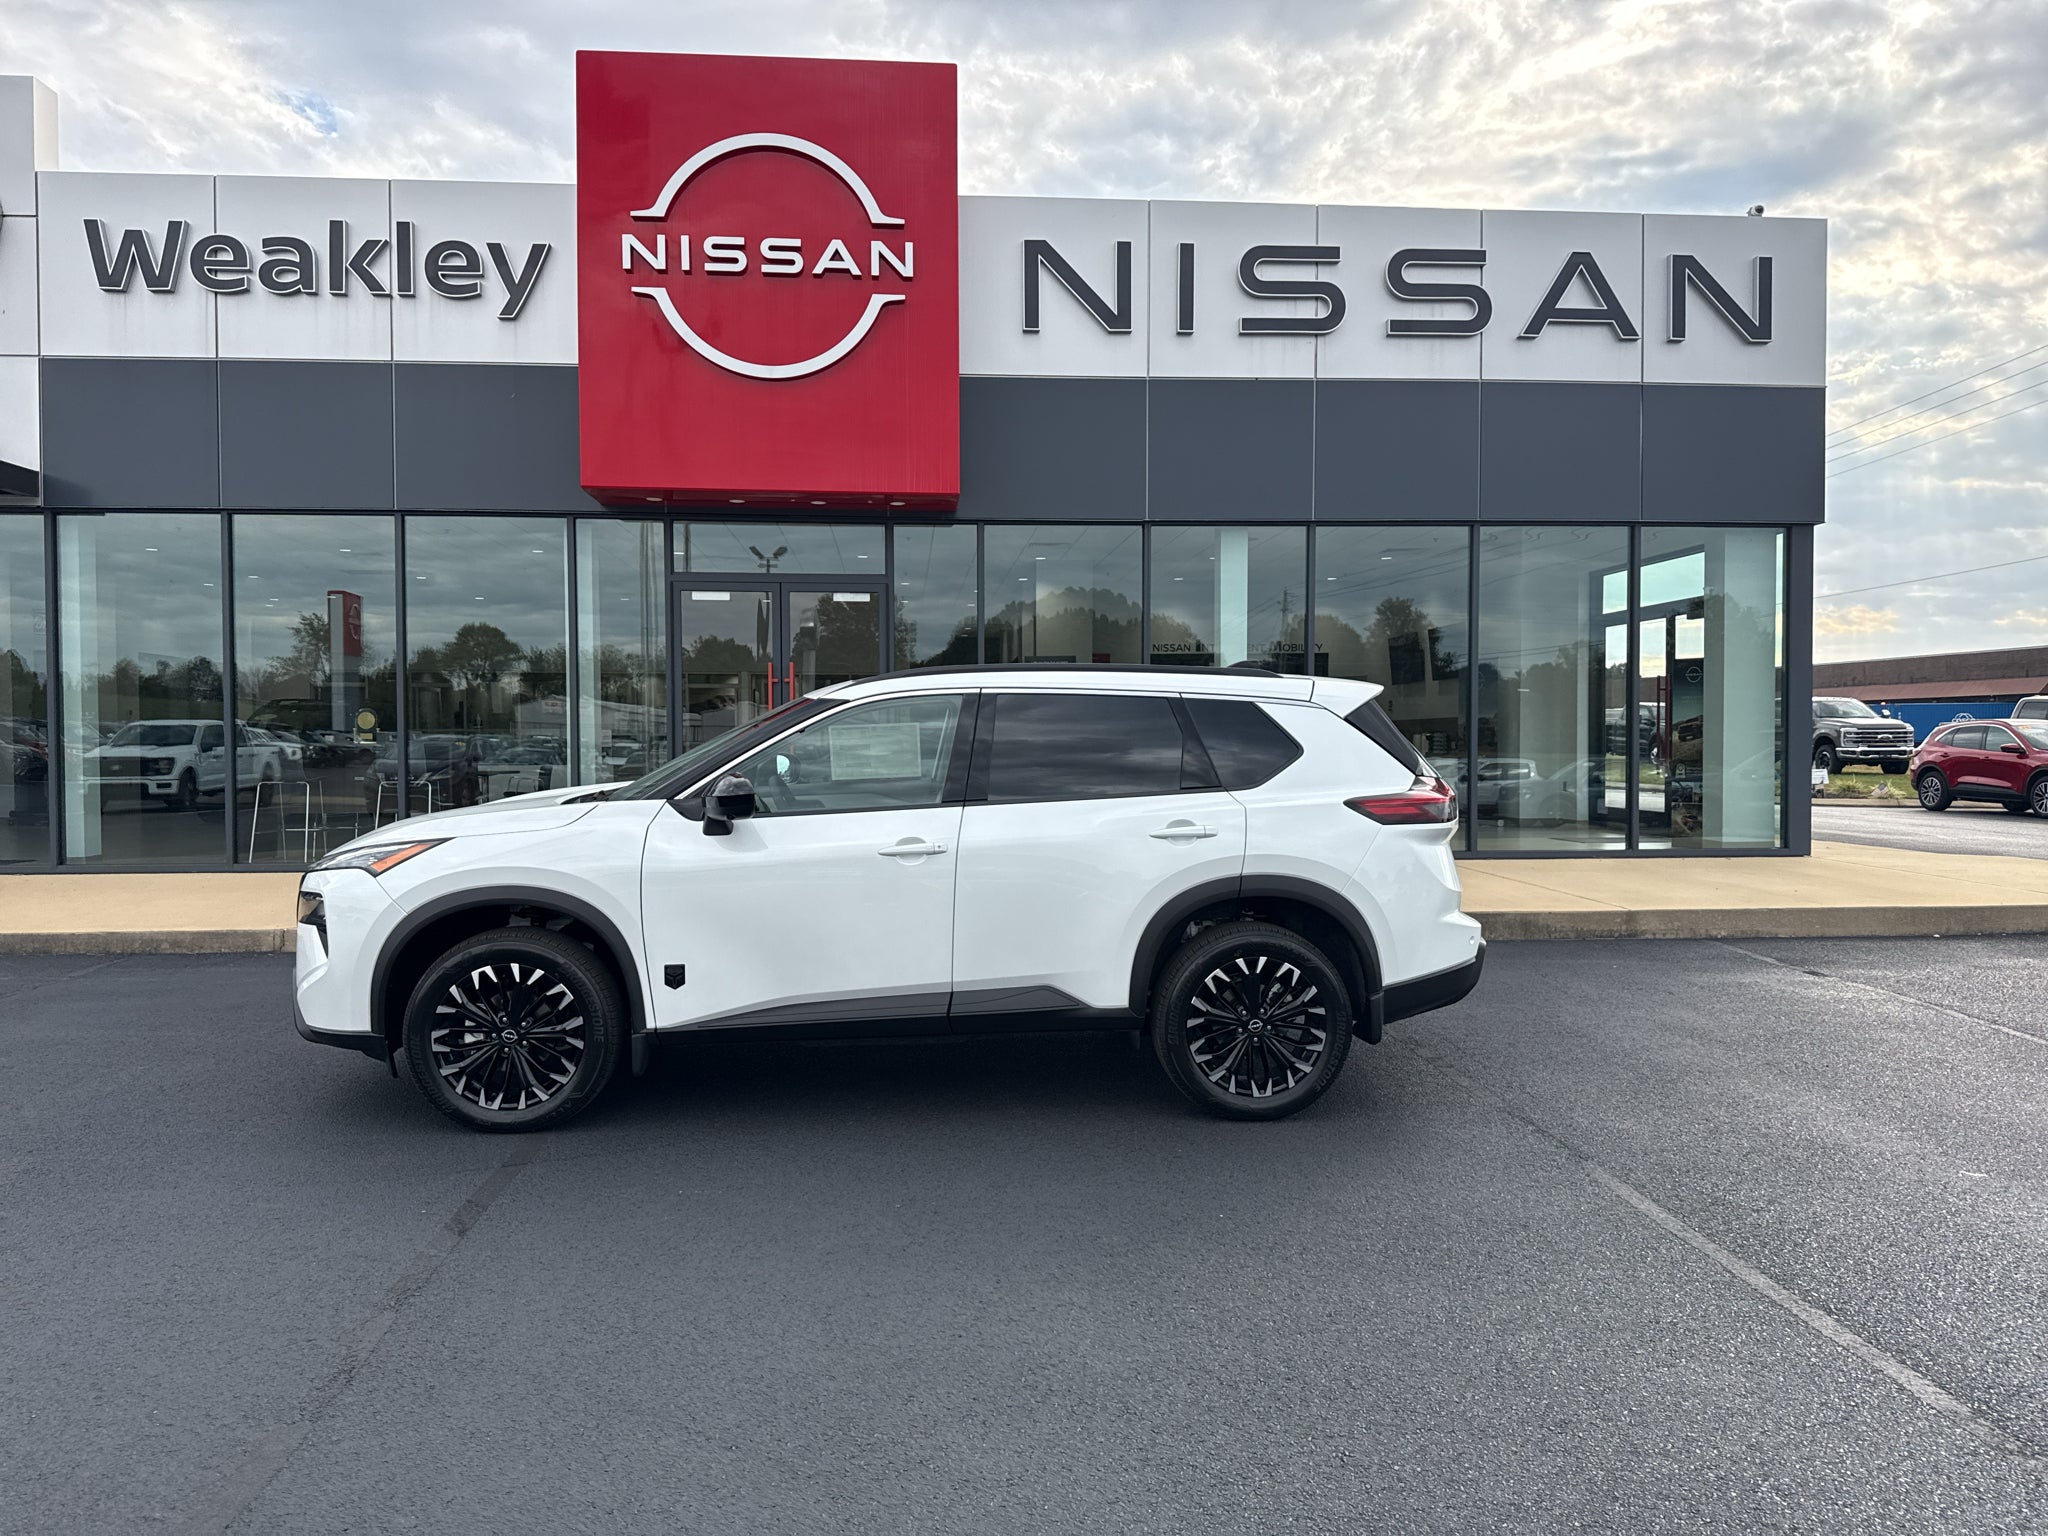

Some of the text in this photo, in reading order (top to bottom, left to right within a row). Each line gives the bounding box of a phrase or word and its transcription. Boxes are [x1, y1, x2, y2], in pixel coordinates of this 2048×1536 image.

[83, 218, 552, 320] Weakley
[621, 233, 914, 278] NISSAN
[1022, 238, 1774, 343] NISSAN
[1152, 643, 1191, 653] NISSAN
[1270, 640, 1324, 653] MOBILY
[1313, 1008, 1347, 1094] BRIDGESTONE
